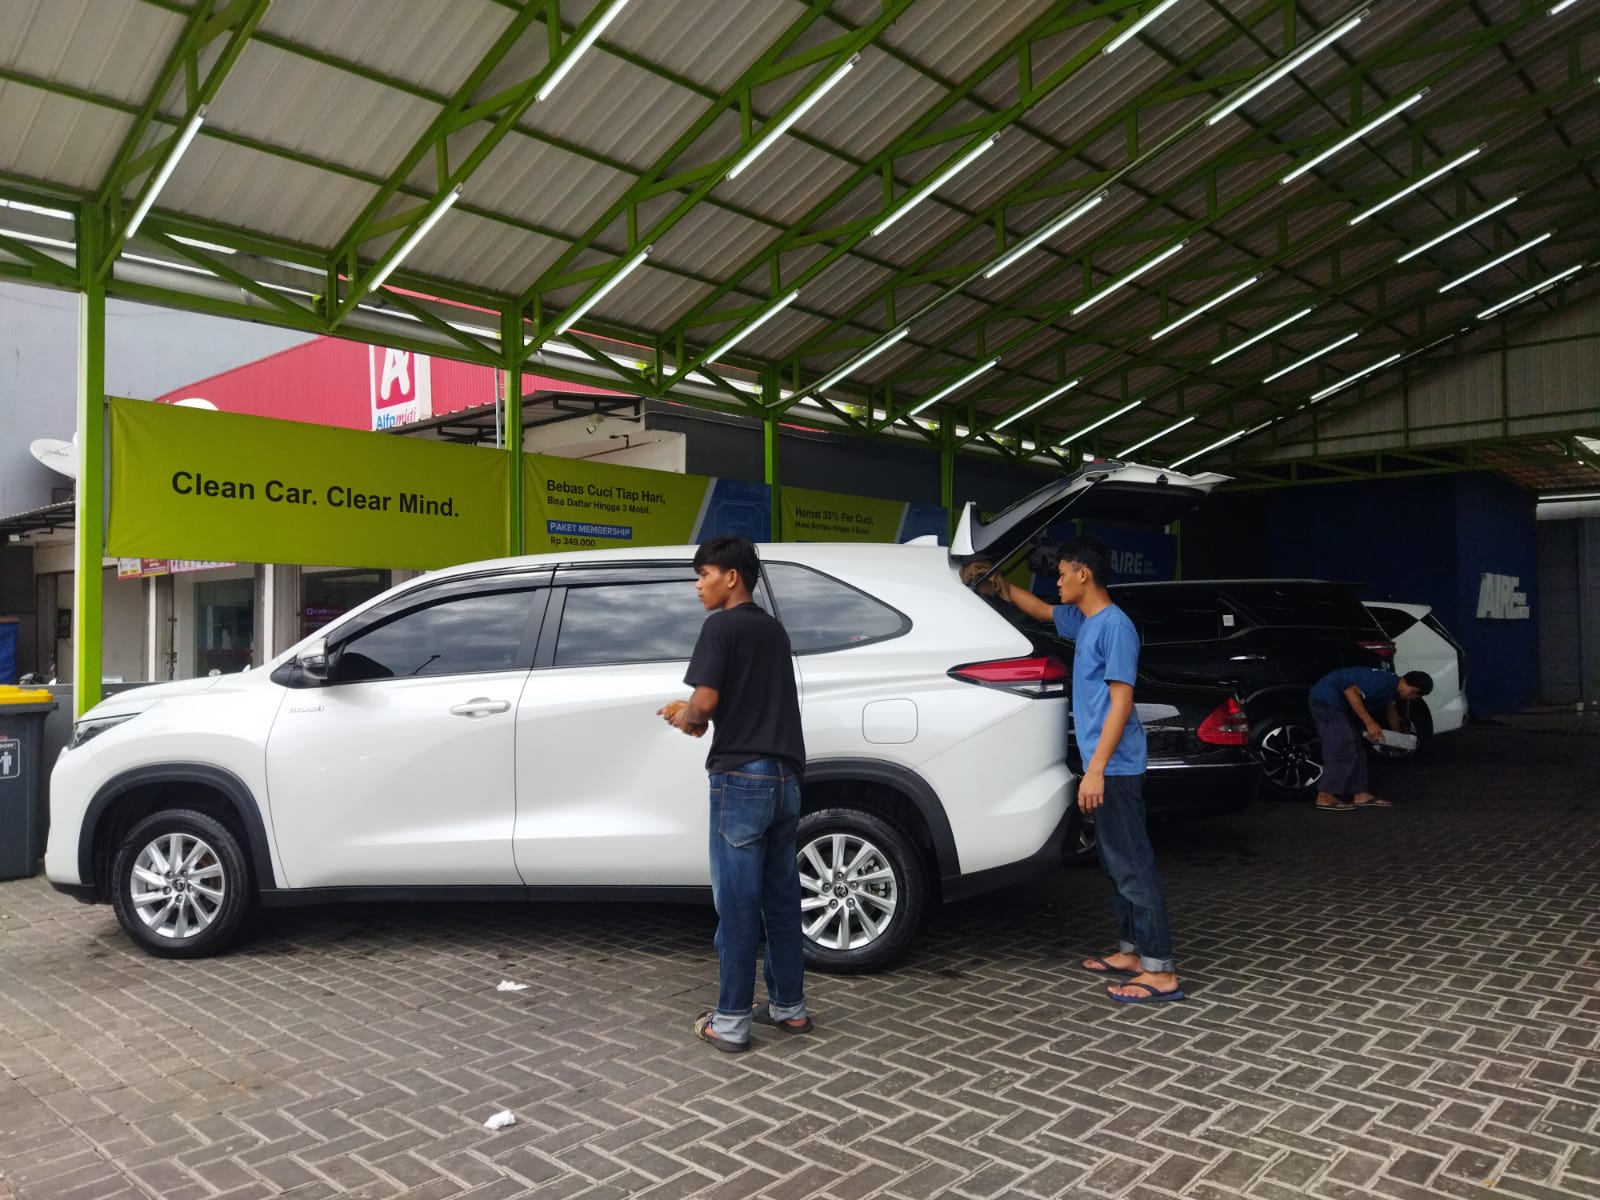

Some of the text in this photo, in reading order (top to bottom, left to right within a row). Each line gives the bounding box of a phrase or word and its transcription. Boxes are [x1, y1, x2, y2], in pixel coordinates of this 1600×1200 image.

[172, 471, 459, 517] Clean Car. Clear Mind.
[547, 480, 666, 505] Bebas Cuci Tiap Hari,
[547, 496, 564, 506] Bisa
[567, 498, 591, 509] Daftar
[593, 502, 620, 512] Hingga
[622, 503, 627, 512] 3
[795, 507, 821, 519] Hemat
[841, 512, 854, 522] Per
[550, 522, 631, 536] PAKET MEMBERSHIP
[550, 537, 596, 546] Rp 349.000
